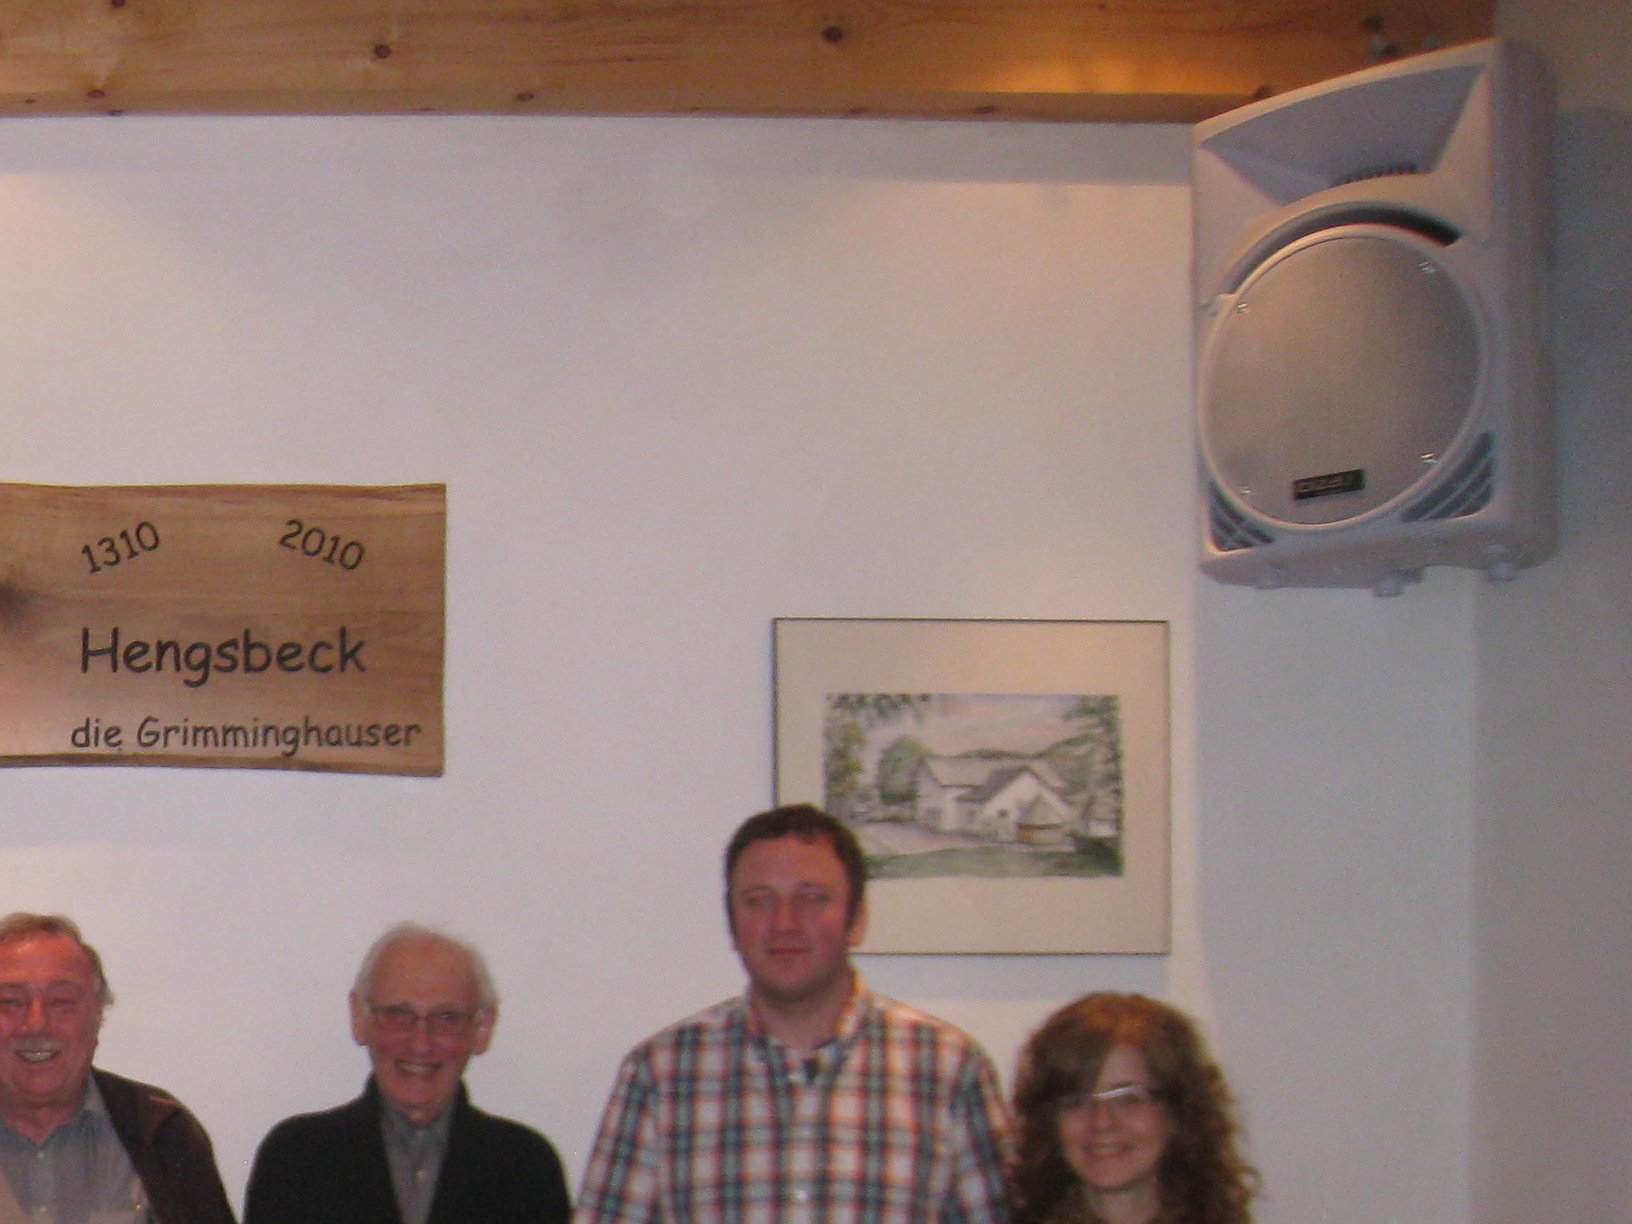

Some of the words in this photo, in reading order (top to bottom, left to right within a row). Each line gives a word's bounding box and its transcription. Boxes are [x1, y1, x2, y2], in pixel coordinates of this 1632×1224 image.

[80, 520, 161, 575] 1310
[278, 518, 366, 571] 2010
[80, 626, 367, 688] Hengsbeck
[70, 716, 125, 749] die
[135, 716, 422, 758] Grimminghauser
